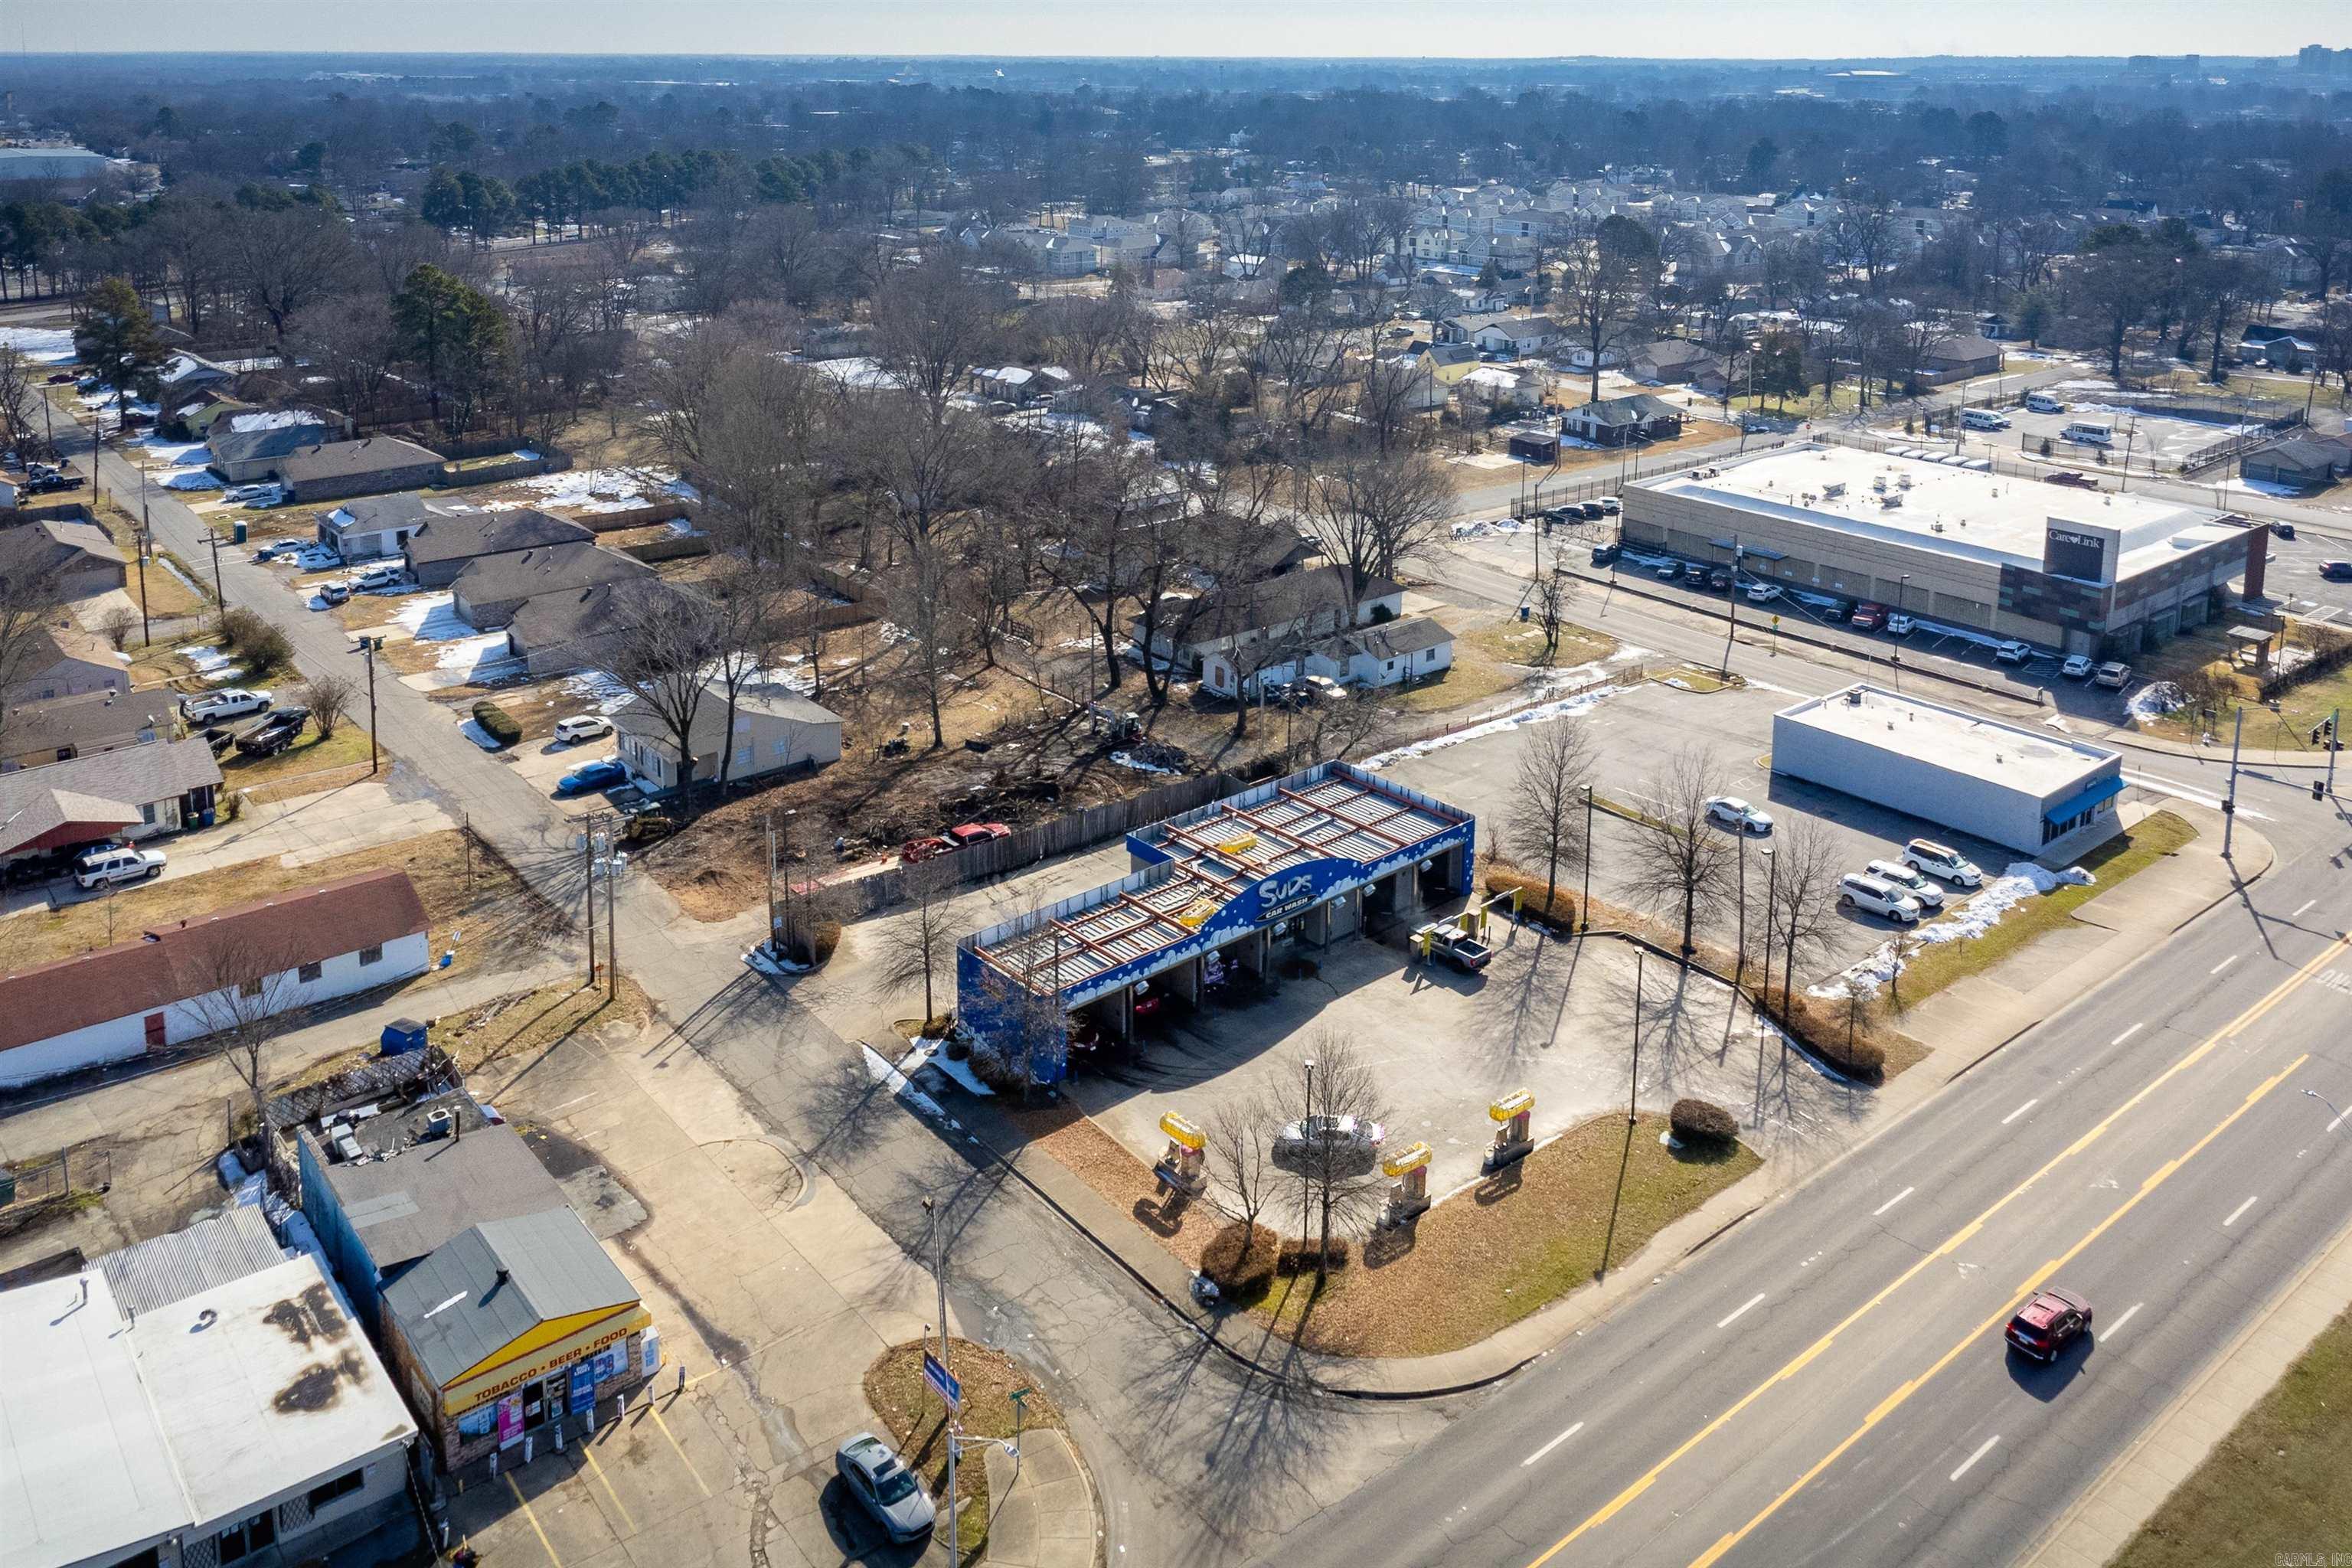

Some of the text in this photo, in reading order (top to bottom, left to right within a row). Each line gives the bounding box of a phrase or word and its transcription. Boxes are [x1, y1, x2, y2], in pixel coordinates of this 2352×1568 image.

[1266, 897, 1308, 918] CAR WASH
[2315, 969, 2352, 995] ONL
[475, 1328, 627, 1401] TOBACCO BEER FOOD
